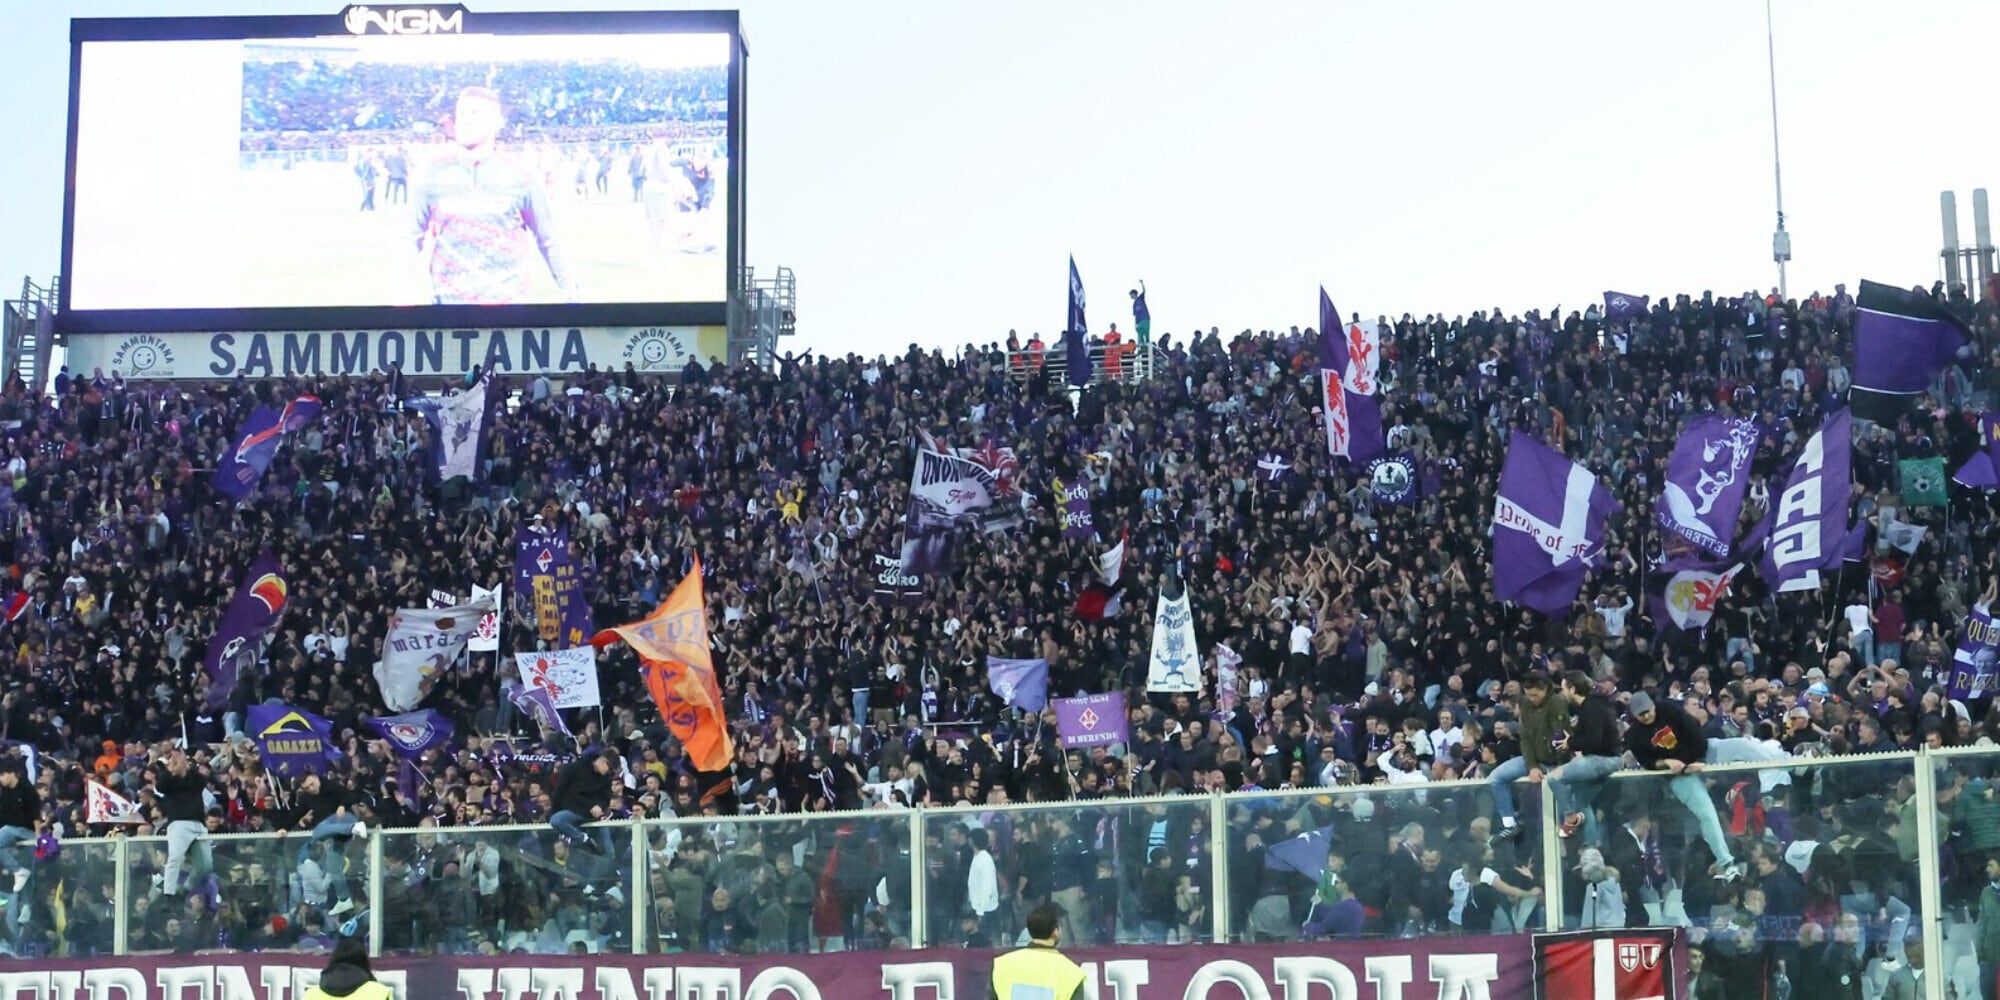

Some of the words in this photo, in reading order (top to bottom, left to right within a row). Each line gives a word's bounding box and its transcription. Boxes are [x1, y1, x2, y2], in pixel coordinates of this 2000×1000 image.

[345, 6, 463, 34] NGM
[112, 335, 174, 365] SAMMONTANA
[209, 329, 588, 378] SAMMONTANA
[623, 328, 684, 358] SAMMONTANA
[1545, 536, 1563, 551] of
